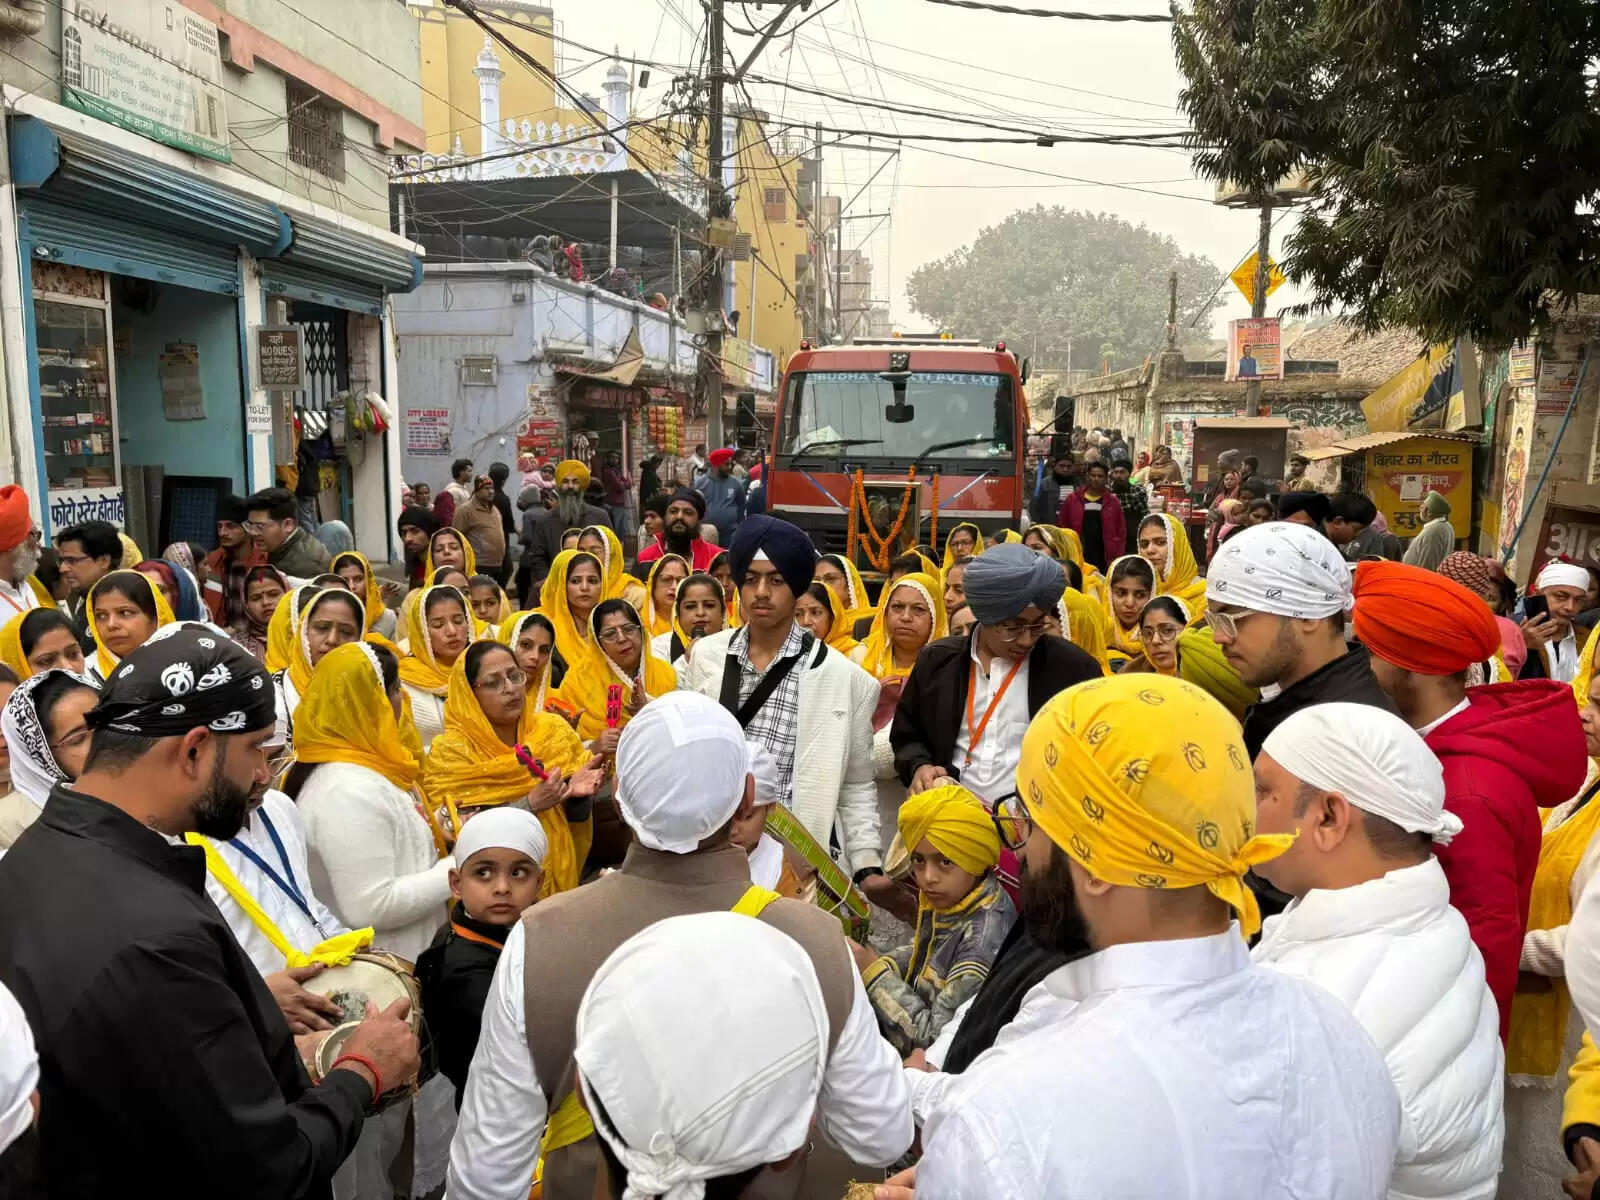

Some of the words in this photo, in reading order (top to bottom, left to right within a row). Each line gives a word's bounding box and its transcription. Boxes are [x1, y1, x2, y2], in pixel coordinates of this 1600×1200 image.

[261, 346, 273, 356] NO
[273, 345, 294, 356] DUES
[1374, 453, 1404, 467] बिहार
[1407, 454, 1422, 465] का
[1424, 450, 1459, 465] गौरव
